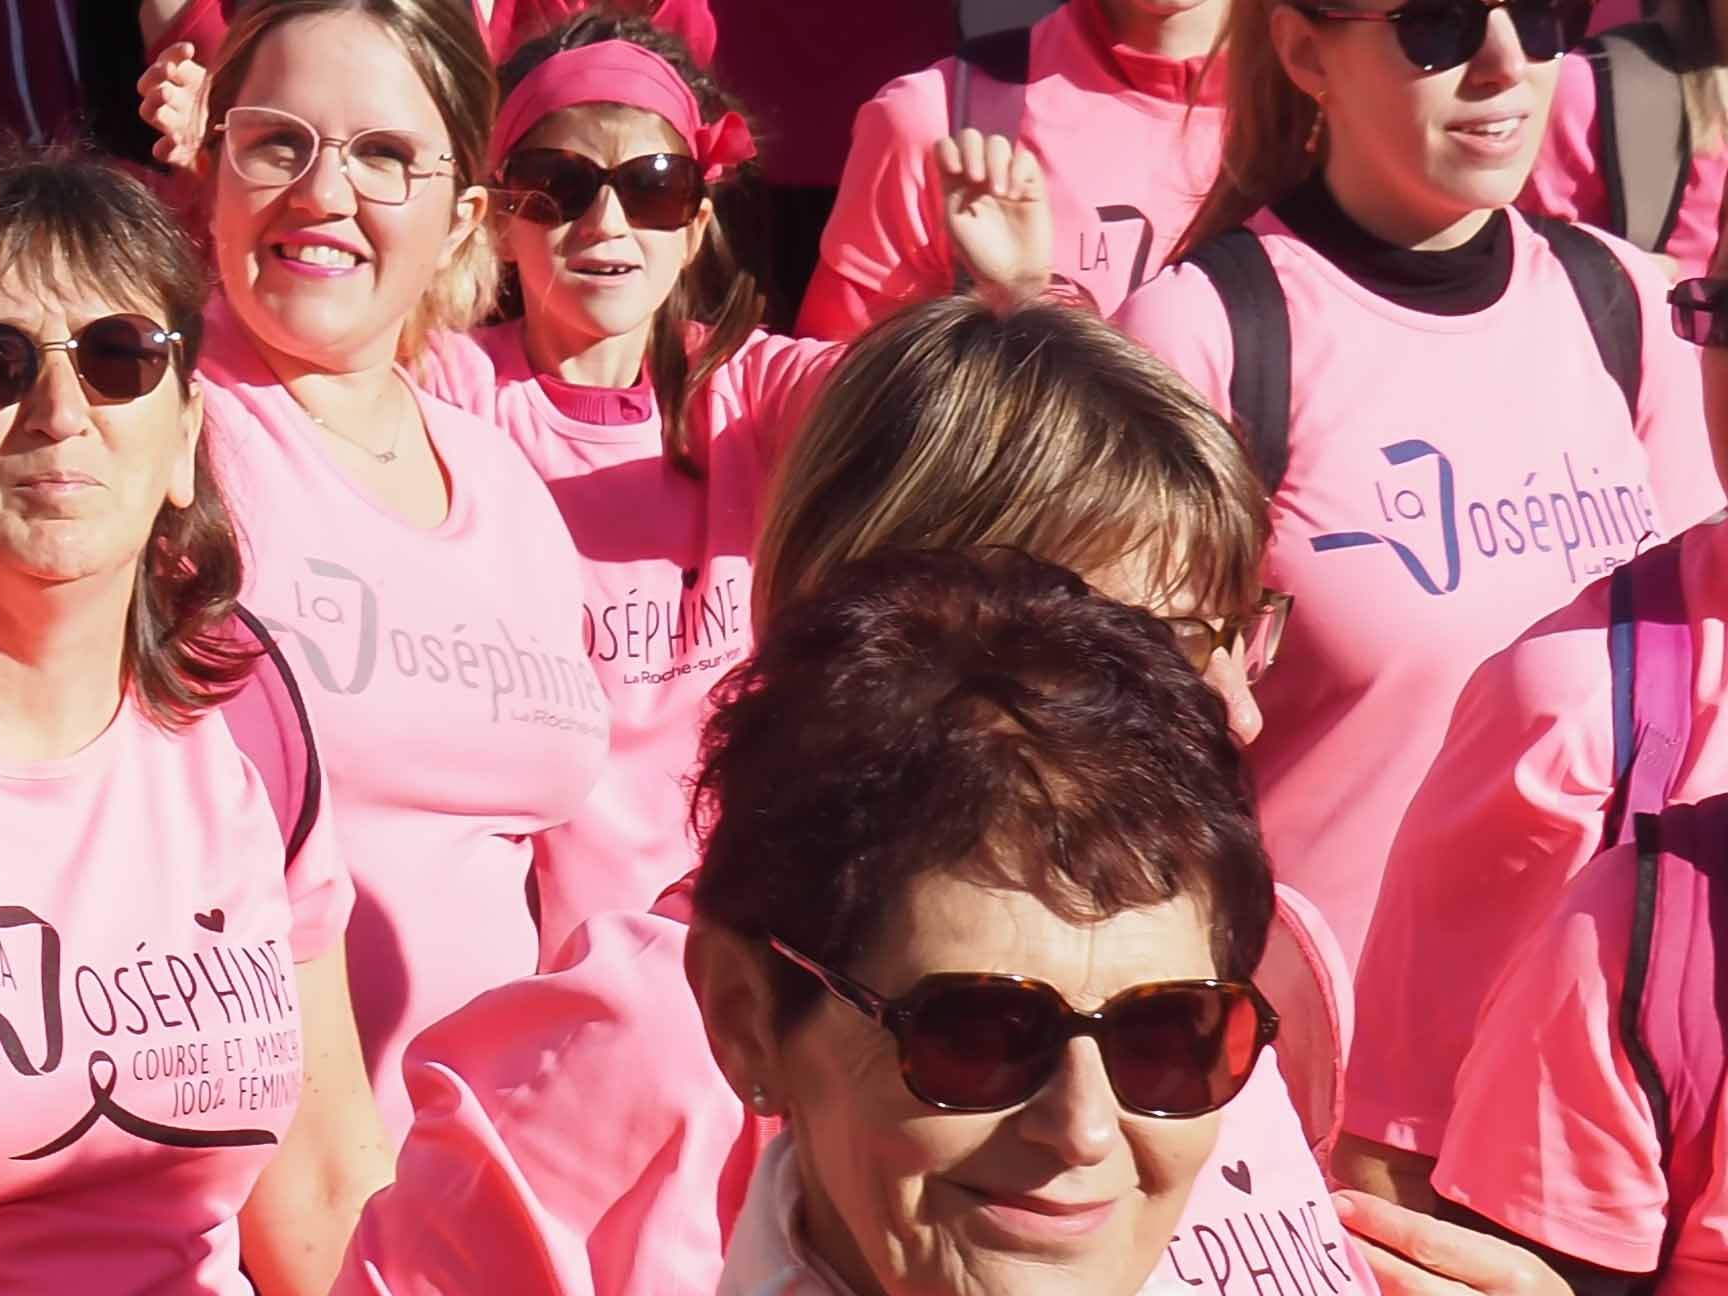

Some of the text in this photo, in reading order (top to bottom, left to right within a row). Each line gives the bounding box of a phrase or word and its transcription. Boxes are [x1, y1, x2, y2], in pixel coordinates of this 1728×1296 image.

[1079, 231, 1110, 271] LA
[1375, 480, 1426, 522] la
[132, 1043, 210, 1081] COURSE
[223, 1037, 245, 1072] ET
[172, 1078, 226, 1117] 100%
